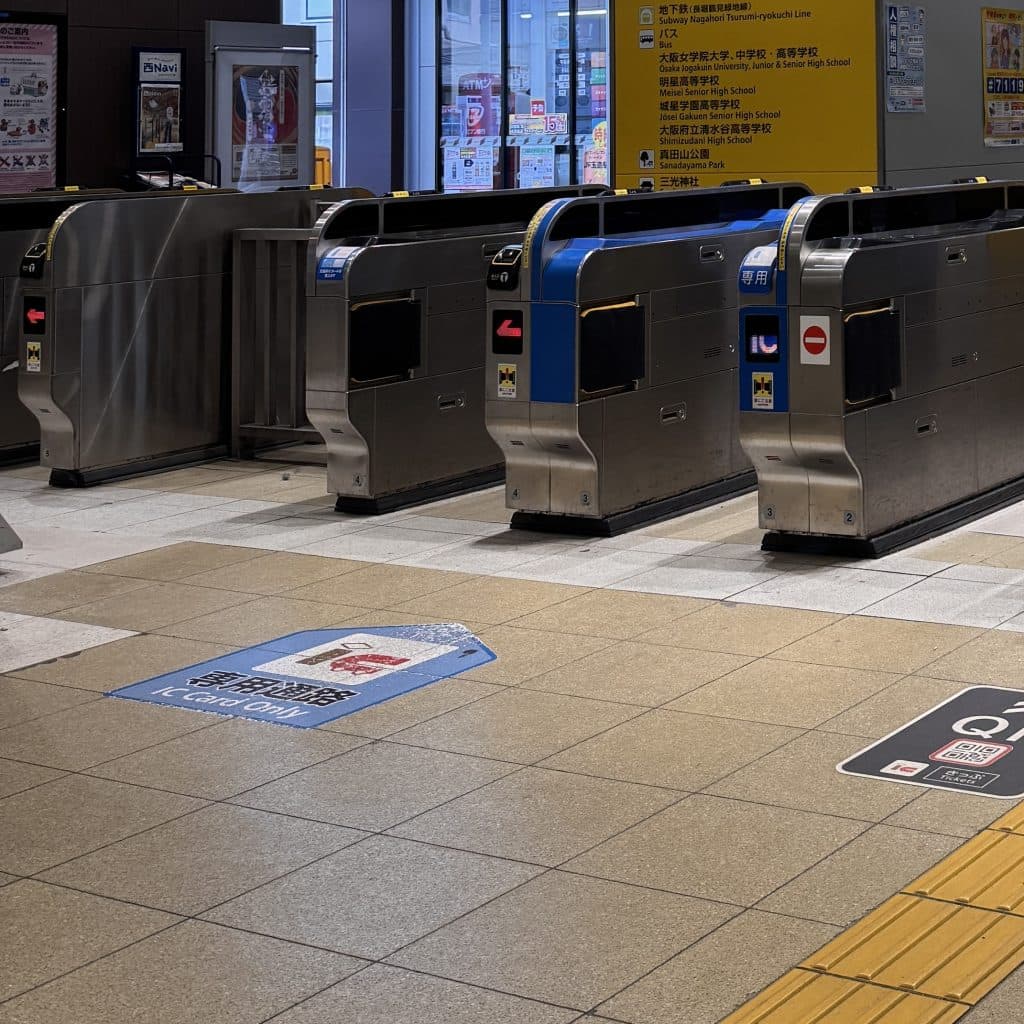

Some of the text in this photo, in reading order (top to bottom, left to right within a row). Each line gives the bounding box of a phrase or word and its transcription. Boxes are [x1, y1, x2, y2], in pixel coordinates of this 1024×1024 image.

[659, 10, 811, 25] Subway Nagahori Tsurumi-ryokuchi Line
[659, 28, 679, 39] バス
[659, 41, 672, 49] Bus
[659, 65, 680, 73] Osaka
[681, 63, 712, 74] Jogakuin
[752, 60, 775, 69] Junior
[775, 60, 782, 68] &
[783, 59, 805, 68] Senior
[807, 59, 825, 68] High
[826, 57, 851, 67] School
[659, 86, 756, 97] Meisei Senior High School
[659, 110, 781, 121] Josei Gakuen Senior High School
[659, 135, 753, 146] Shimizudani High School
[659, 160, 726, 171] Sanadayama Park
[741, 270, 768, 285] 専用
[187, 669, 361, 707] 専用通路
[151, 686, 309, 720] IC Card Only
